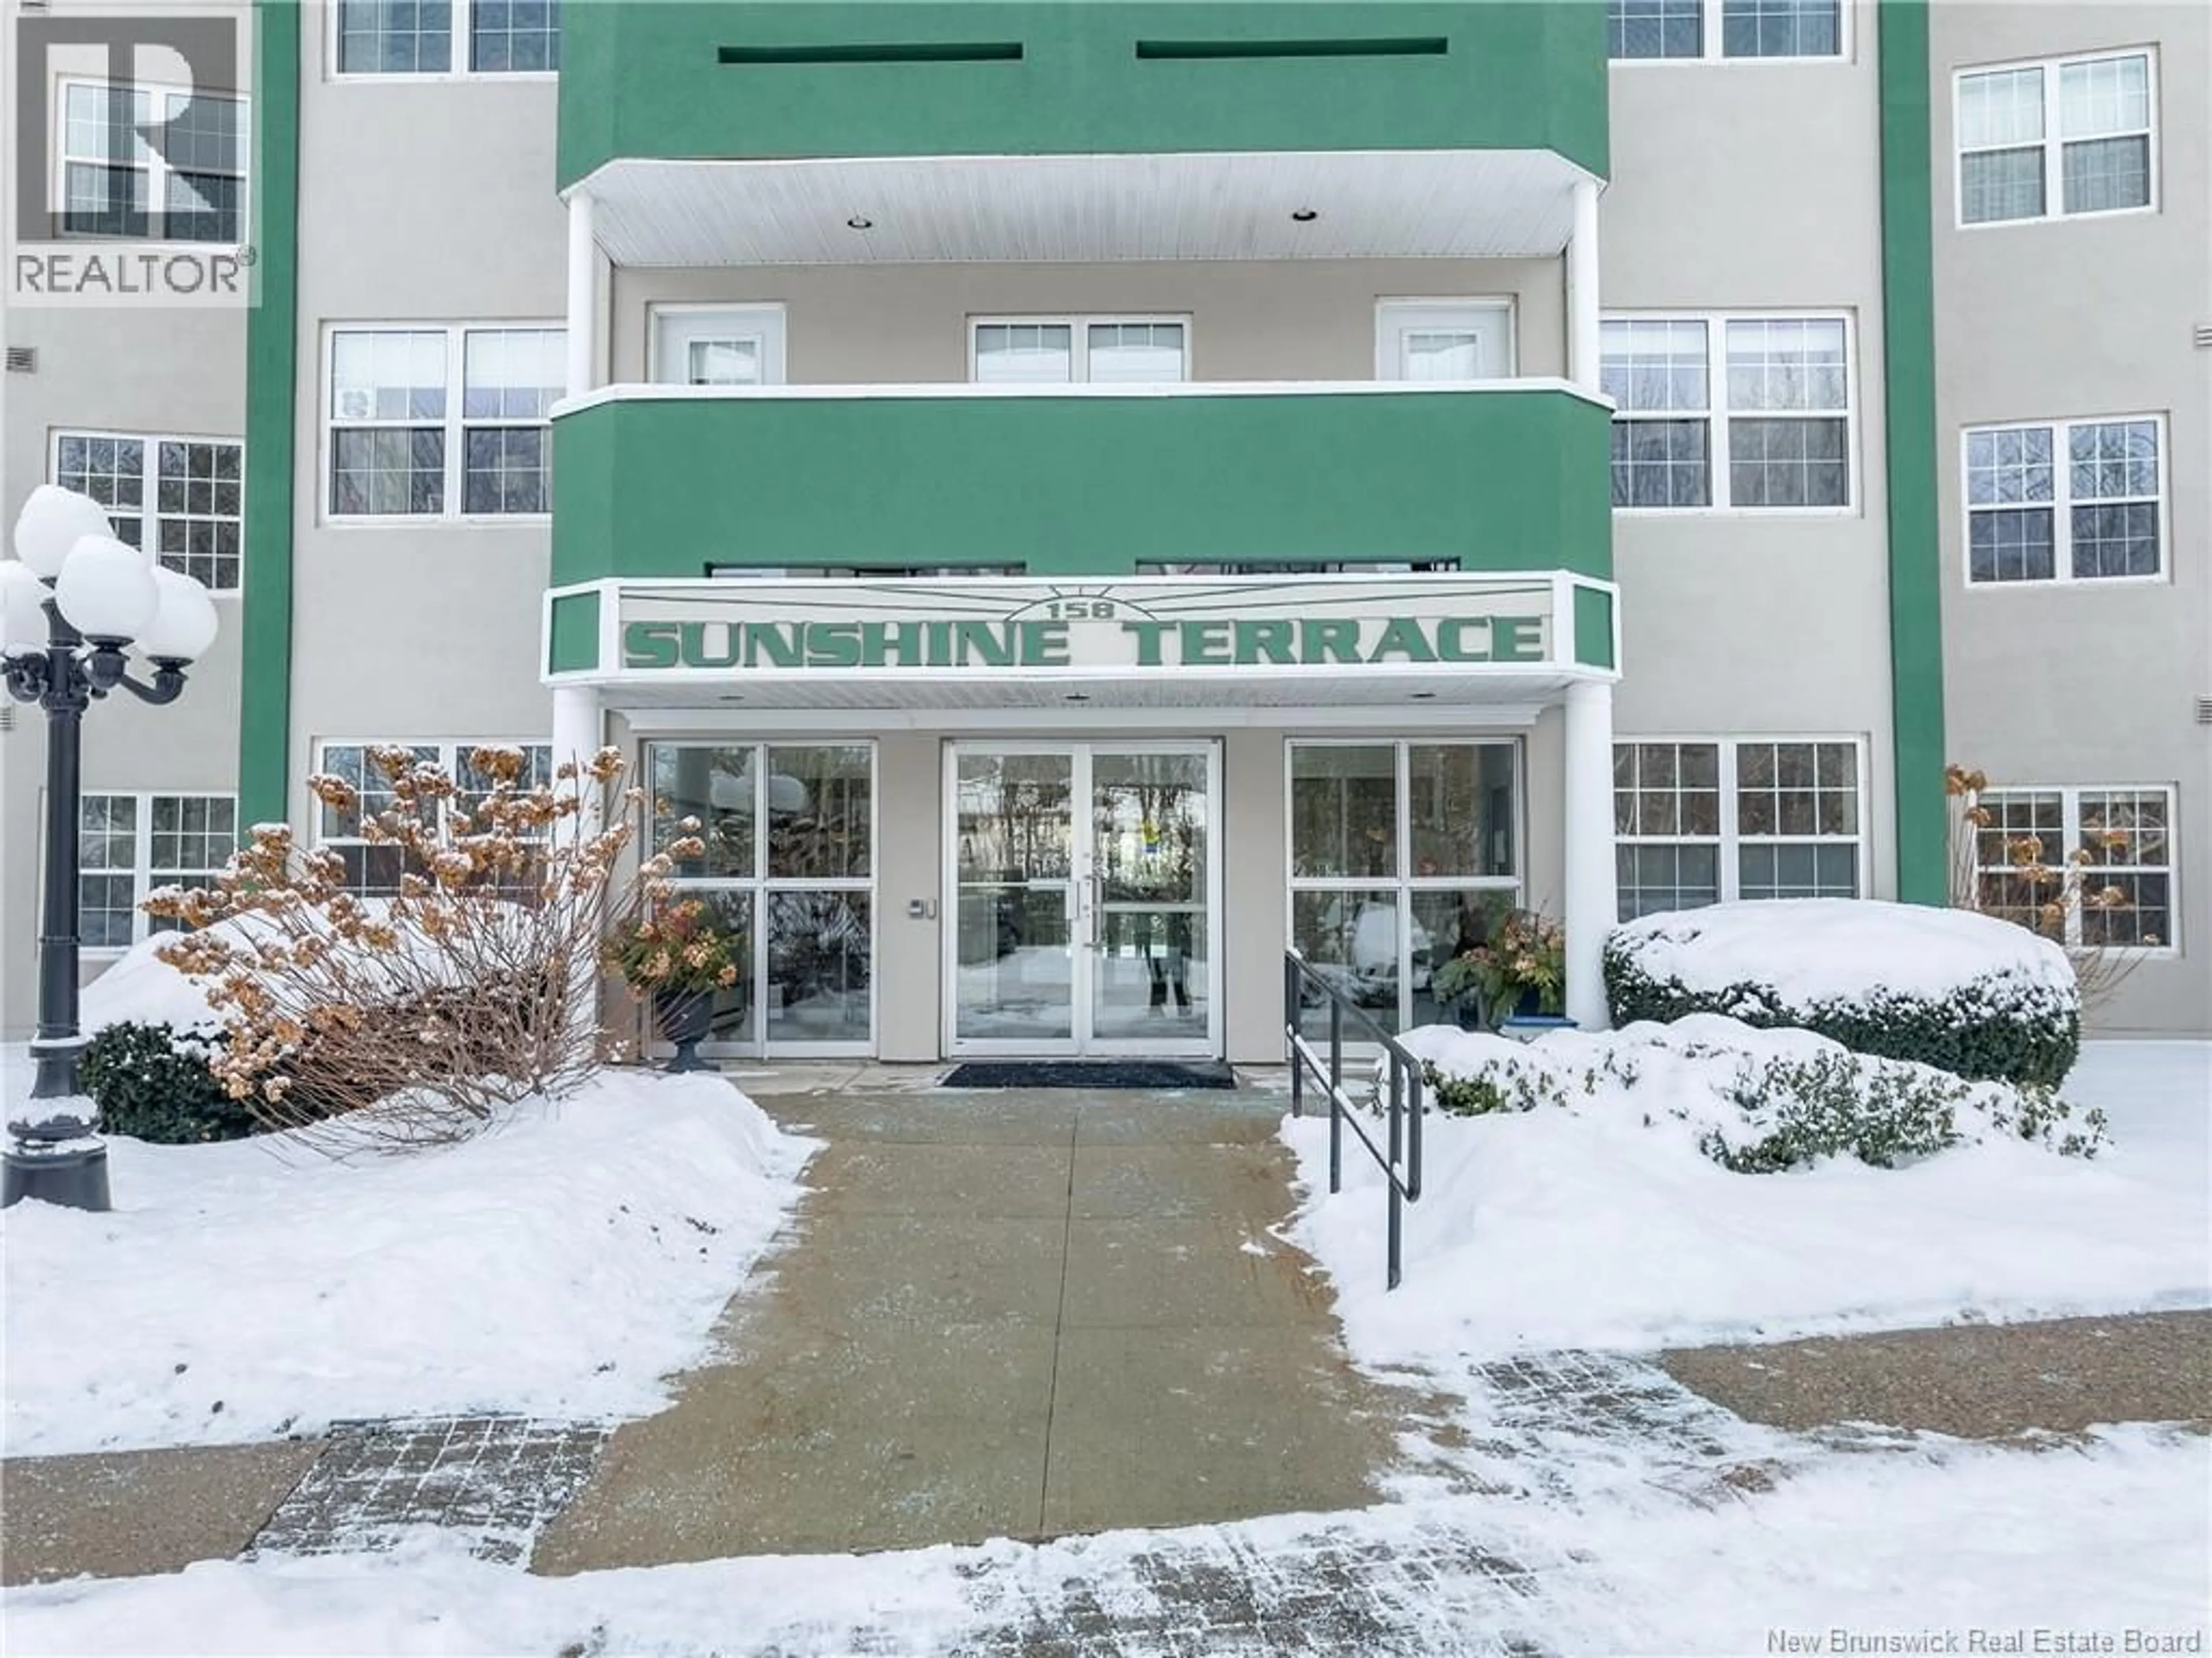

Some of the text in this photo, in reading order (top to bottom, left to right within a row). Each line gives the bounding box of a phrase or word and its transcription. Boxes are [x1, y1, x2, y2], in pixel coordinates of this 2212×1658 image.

[1046, 601, 1115, 619] 158
[624, 616, 1545, 668] SUNSHINE TERRACE
